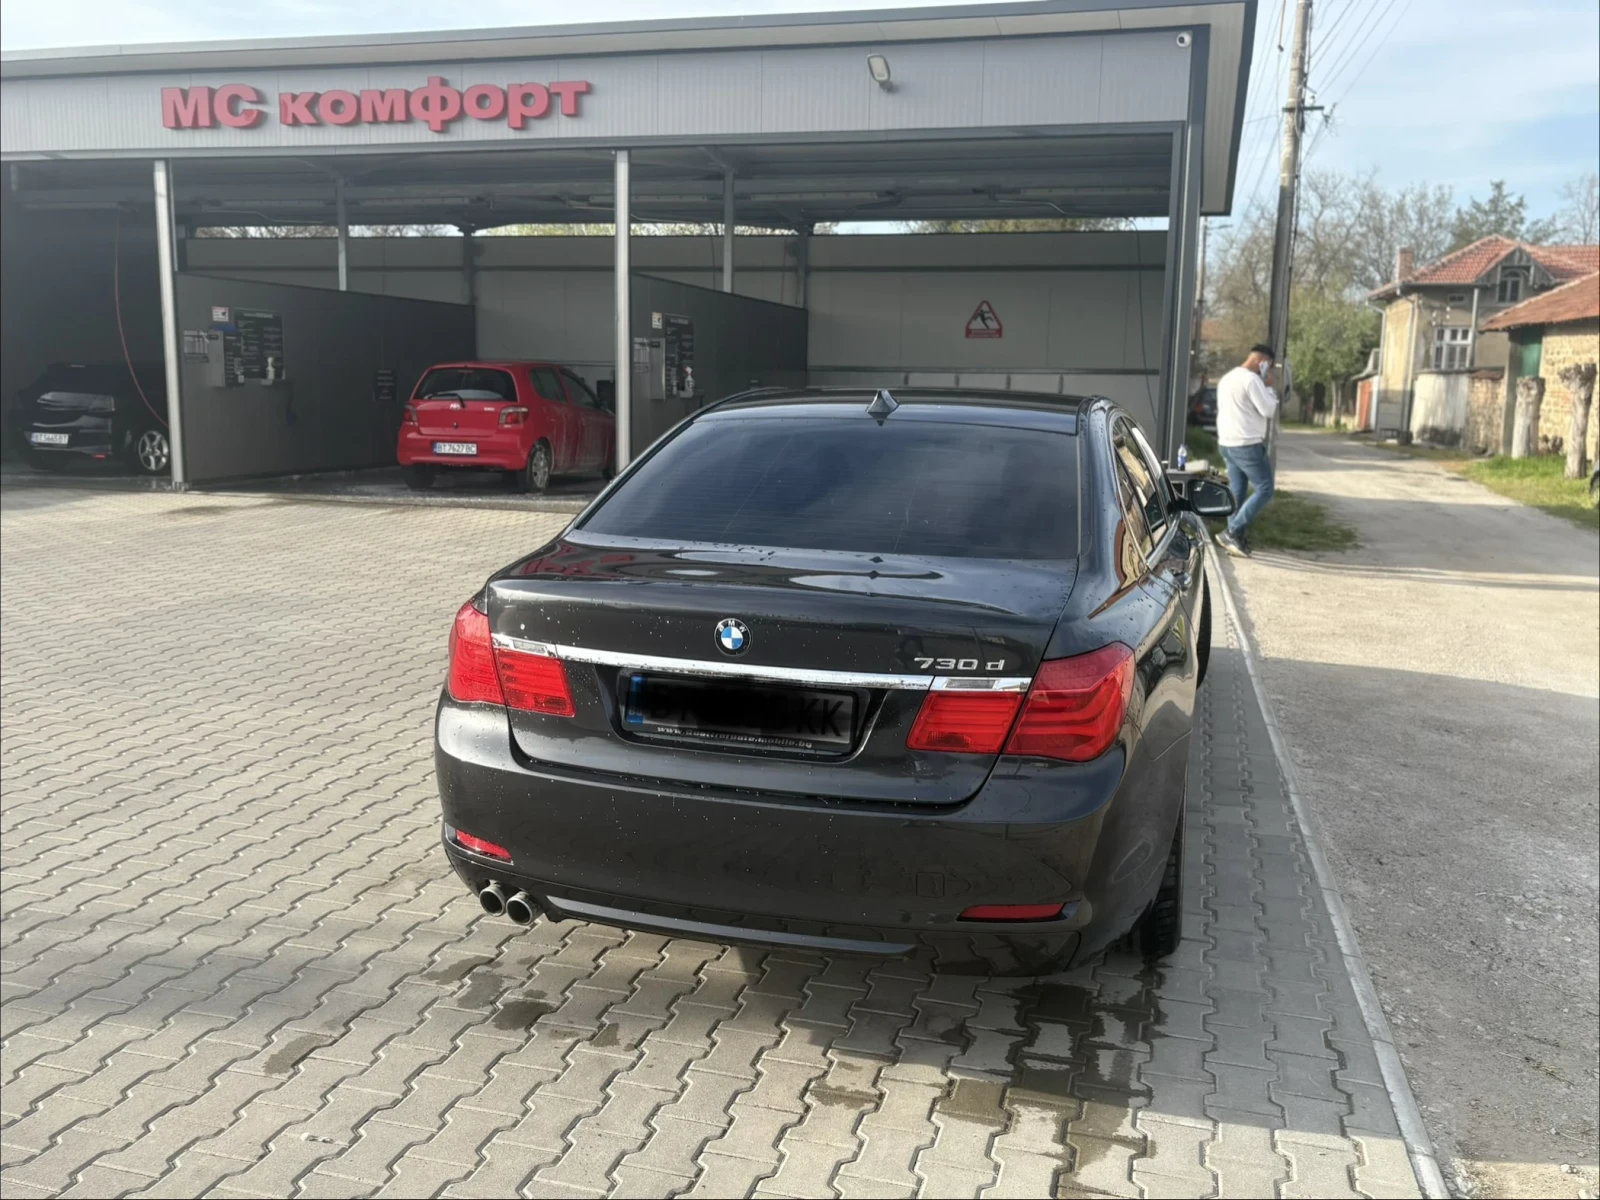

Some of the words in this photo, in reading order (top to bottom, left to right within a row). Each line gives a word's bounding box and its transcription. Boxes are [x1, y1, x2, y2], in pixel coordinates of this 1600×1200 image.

[160, 84, 262, 129] МС
[279, 76, 592, 133] комфорт
[913, 657, 979, 670] 730
[985, 659, 1006, 671] d
